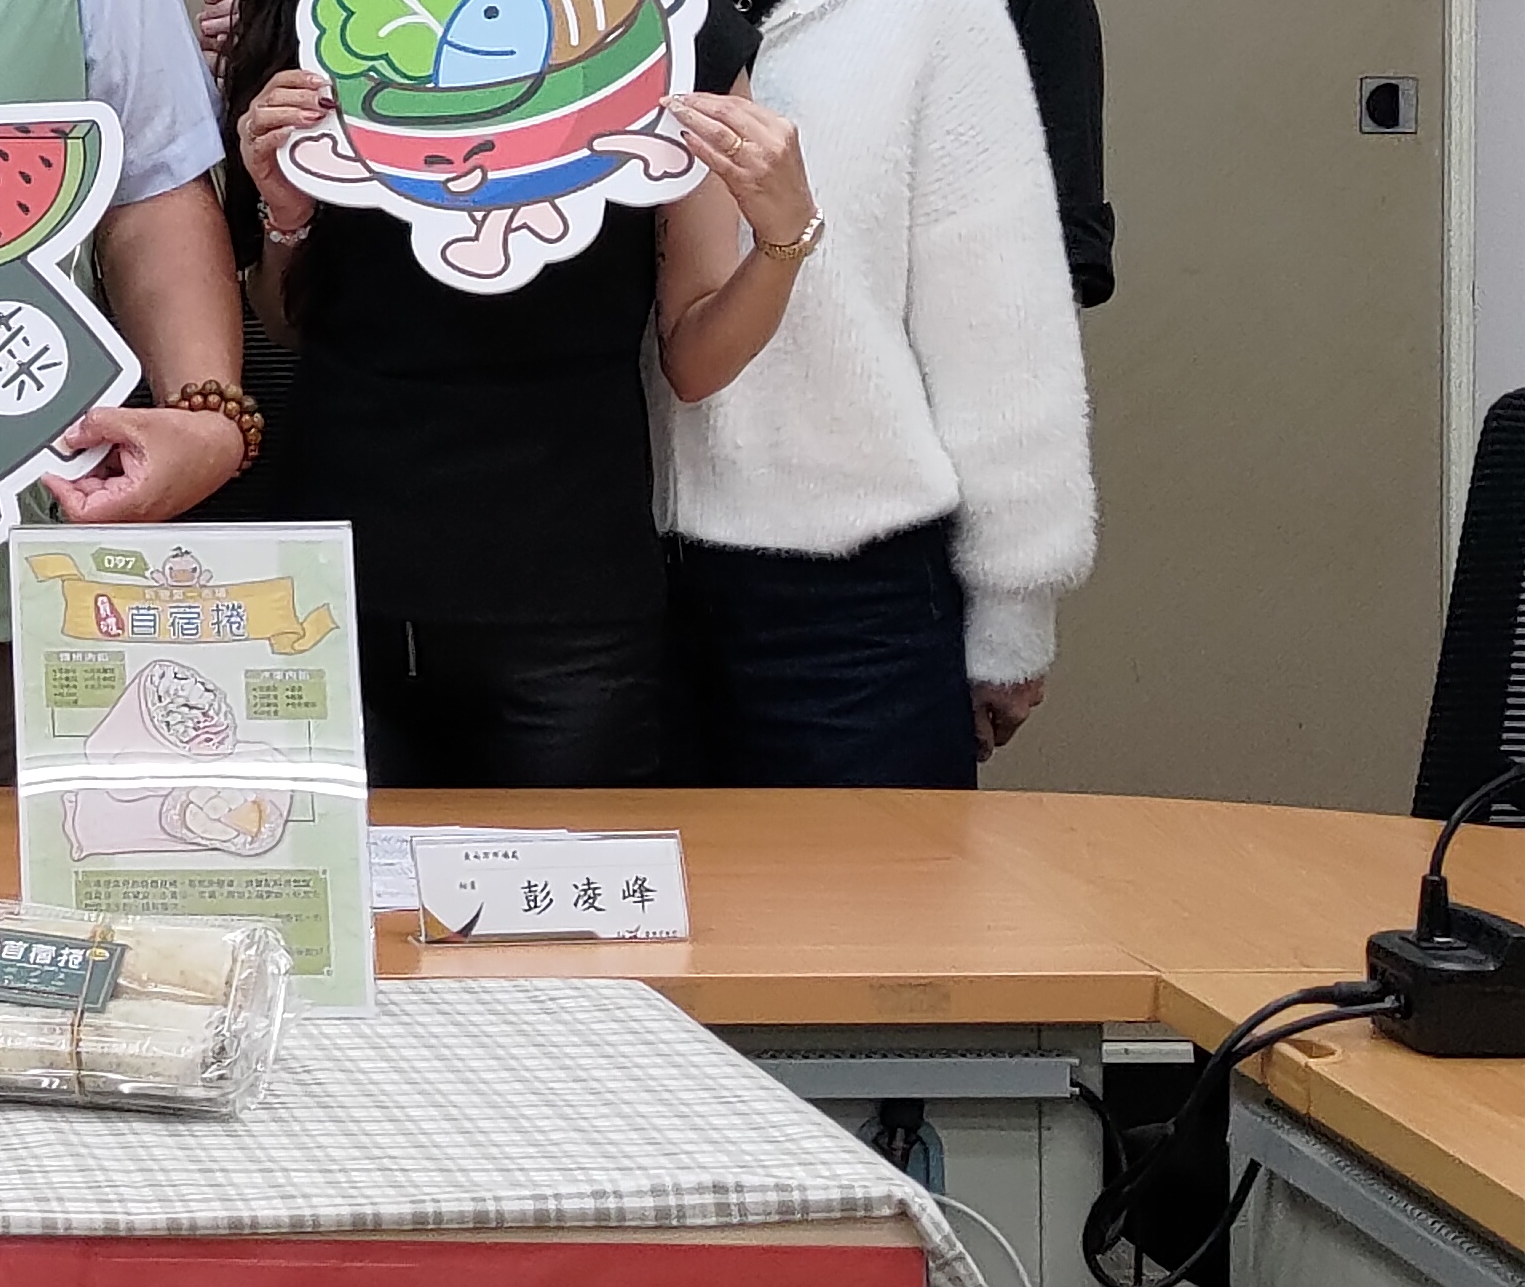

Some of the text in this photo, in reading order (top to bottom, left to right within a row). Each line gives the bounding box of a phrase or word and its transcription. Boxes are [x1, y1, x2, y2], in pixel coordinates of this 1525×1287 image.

[104, 554, 136, 570] 097
[128, 601, 247, 640] 苜蓿捲
[521, 875, 657, 915] 彭凌峰
